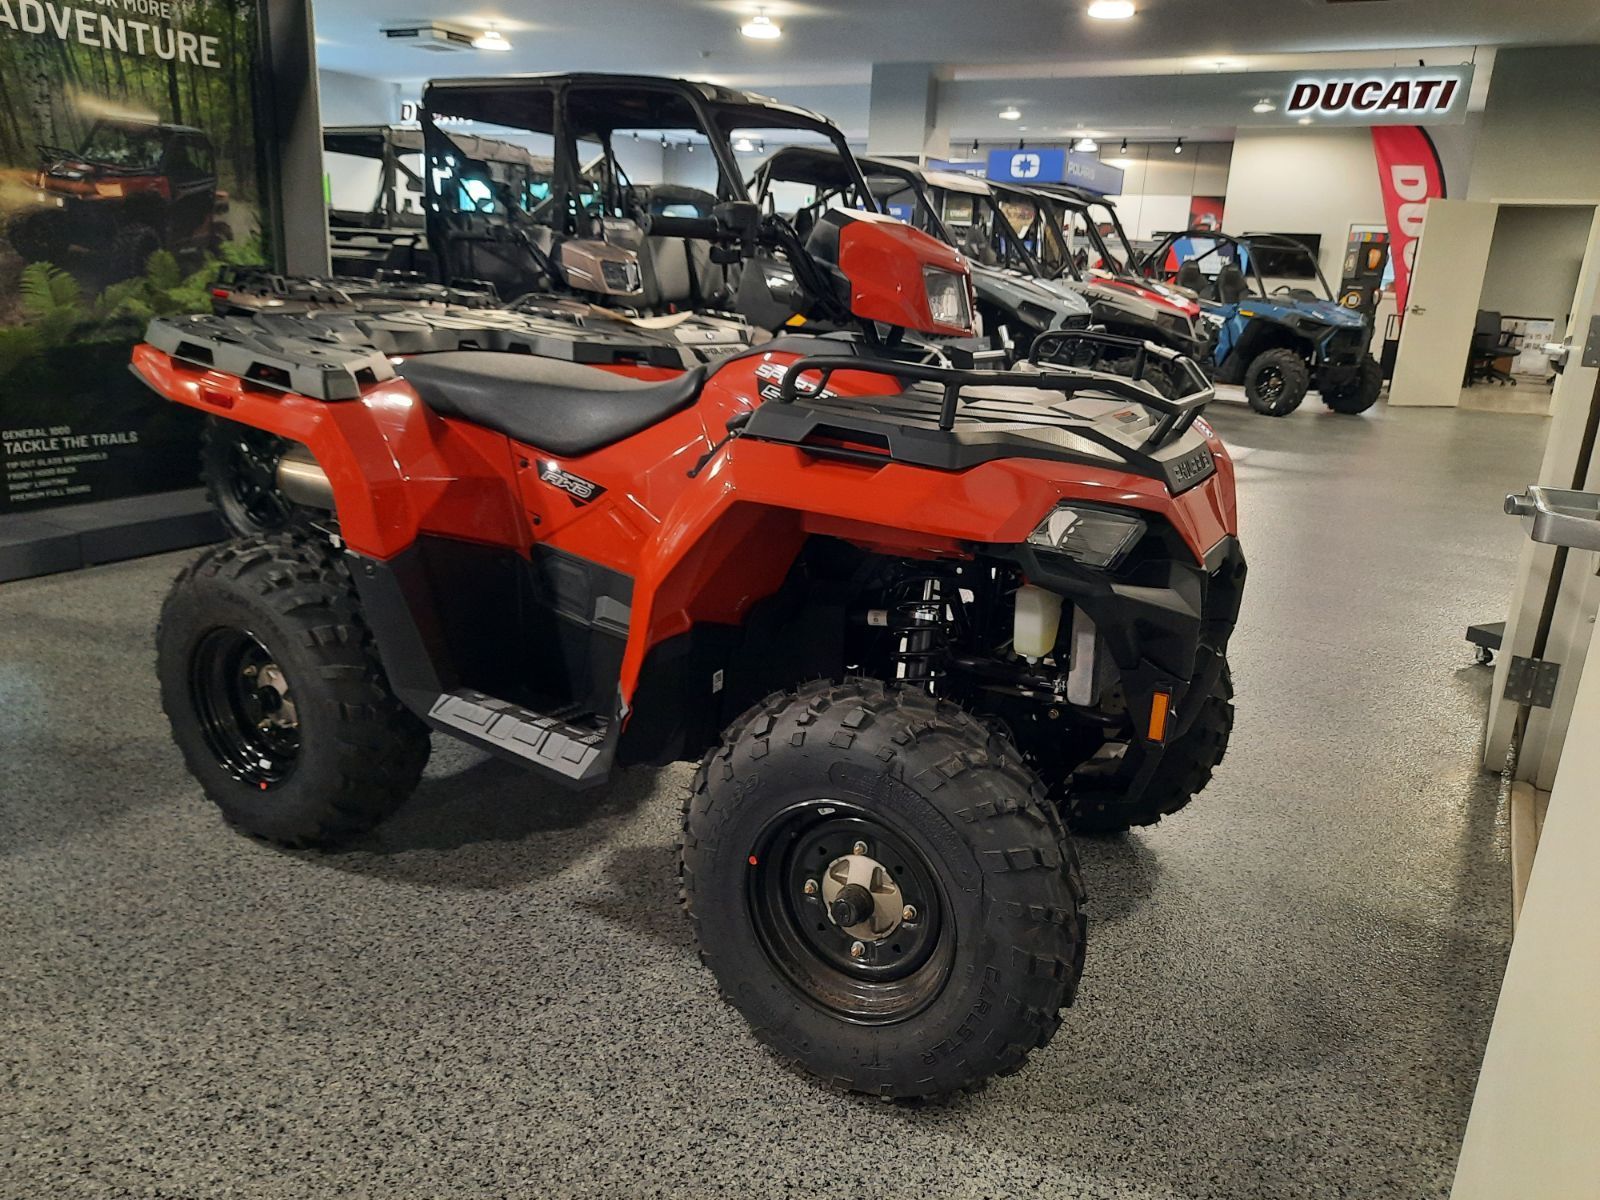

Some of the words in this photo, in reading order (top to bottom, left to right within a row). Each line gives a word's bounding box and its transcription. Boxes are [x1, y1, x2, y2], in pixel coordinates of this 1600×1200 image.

[123, 0, 171, 19] MORE
[0, 0, 221, 68] ADVENTURE
[1288, 80, 1458, 111] DUCATI
[4, 438, 59, 454] TACKLE
[61, 435, 88, 448] THE
[91, 431, 138, 446] TRAILS
